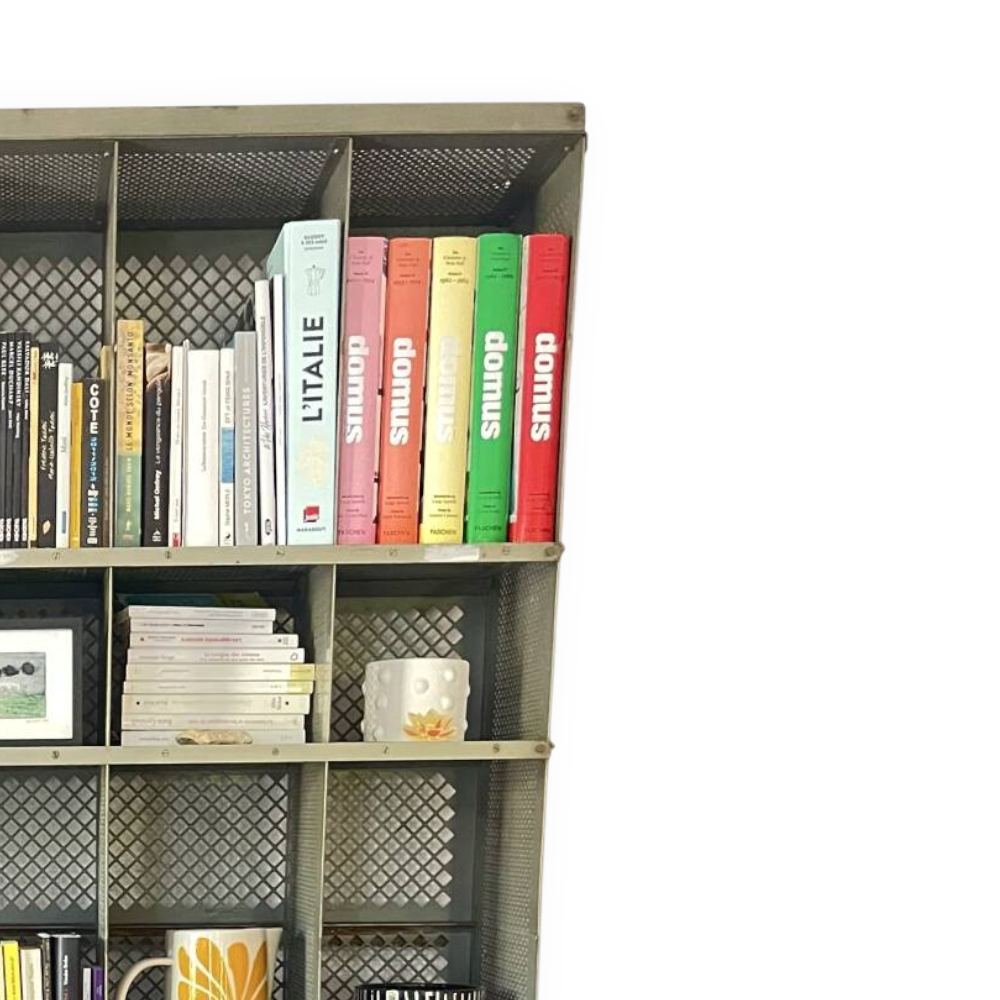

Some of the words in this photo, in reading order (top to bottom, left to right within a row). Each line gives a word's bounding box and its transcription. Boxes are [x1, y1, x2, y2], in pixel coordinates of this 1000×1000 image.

[154, 407, 161, 416] du
[302, 316, 324, 422] L'ITALIE
[347, 336, 369, 444] domus
[390, 338, 416, 446] domus
[436, 336, 460, 443] domus
[481, 331, 508, 440] domus
[531, 333, 558, 442] domus
[126, 441, 133, 451] LE
[242, 387, 251, 475] ARCHITECTURES
[154, 469, 162, 494] Onfray
[243, 478, 252, 514] TOKYO
[430, 528, 457, 536] TASCHEN
